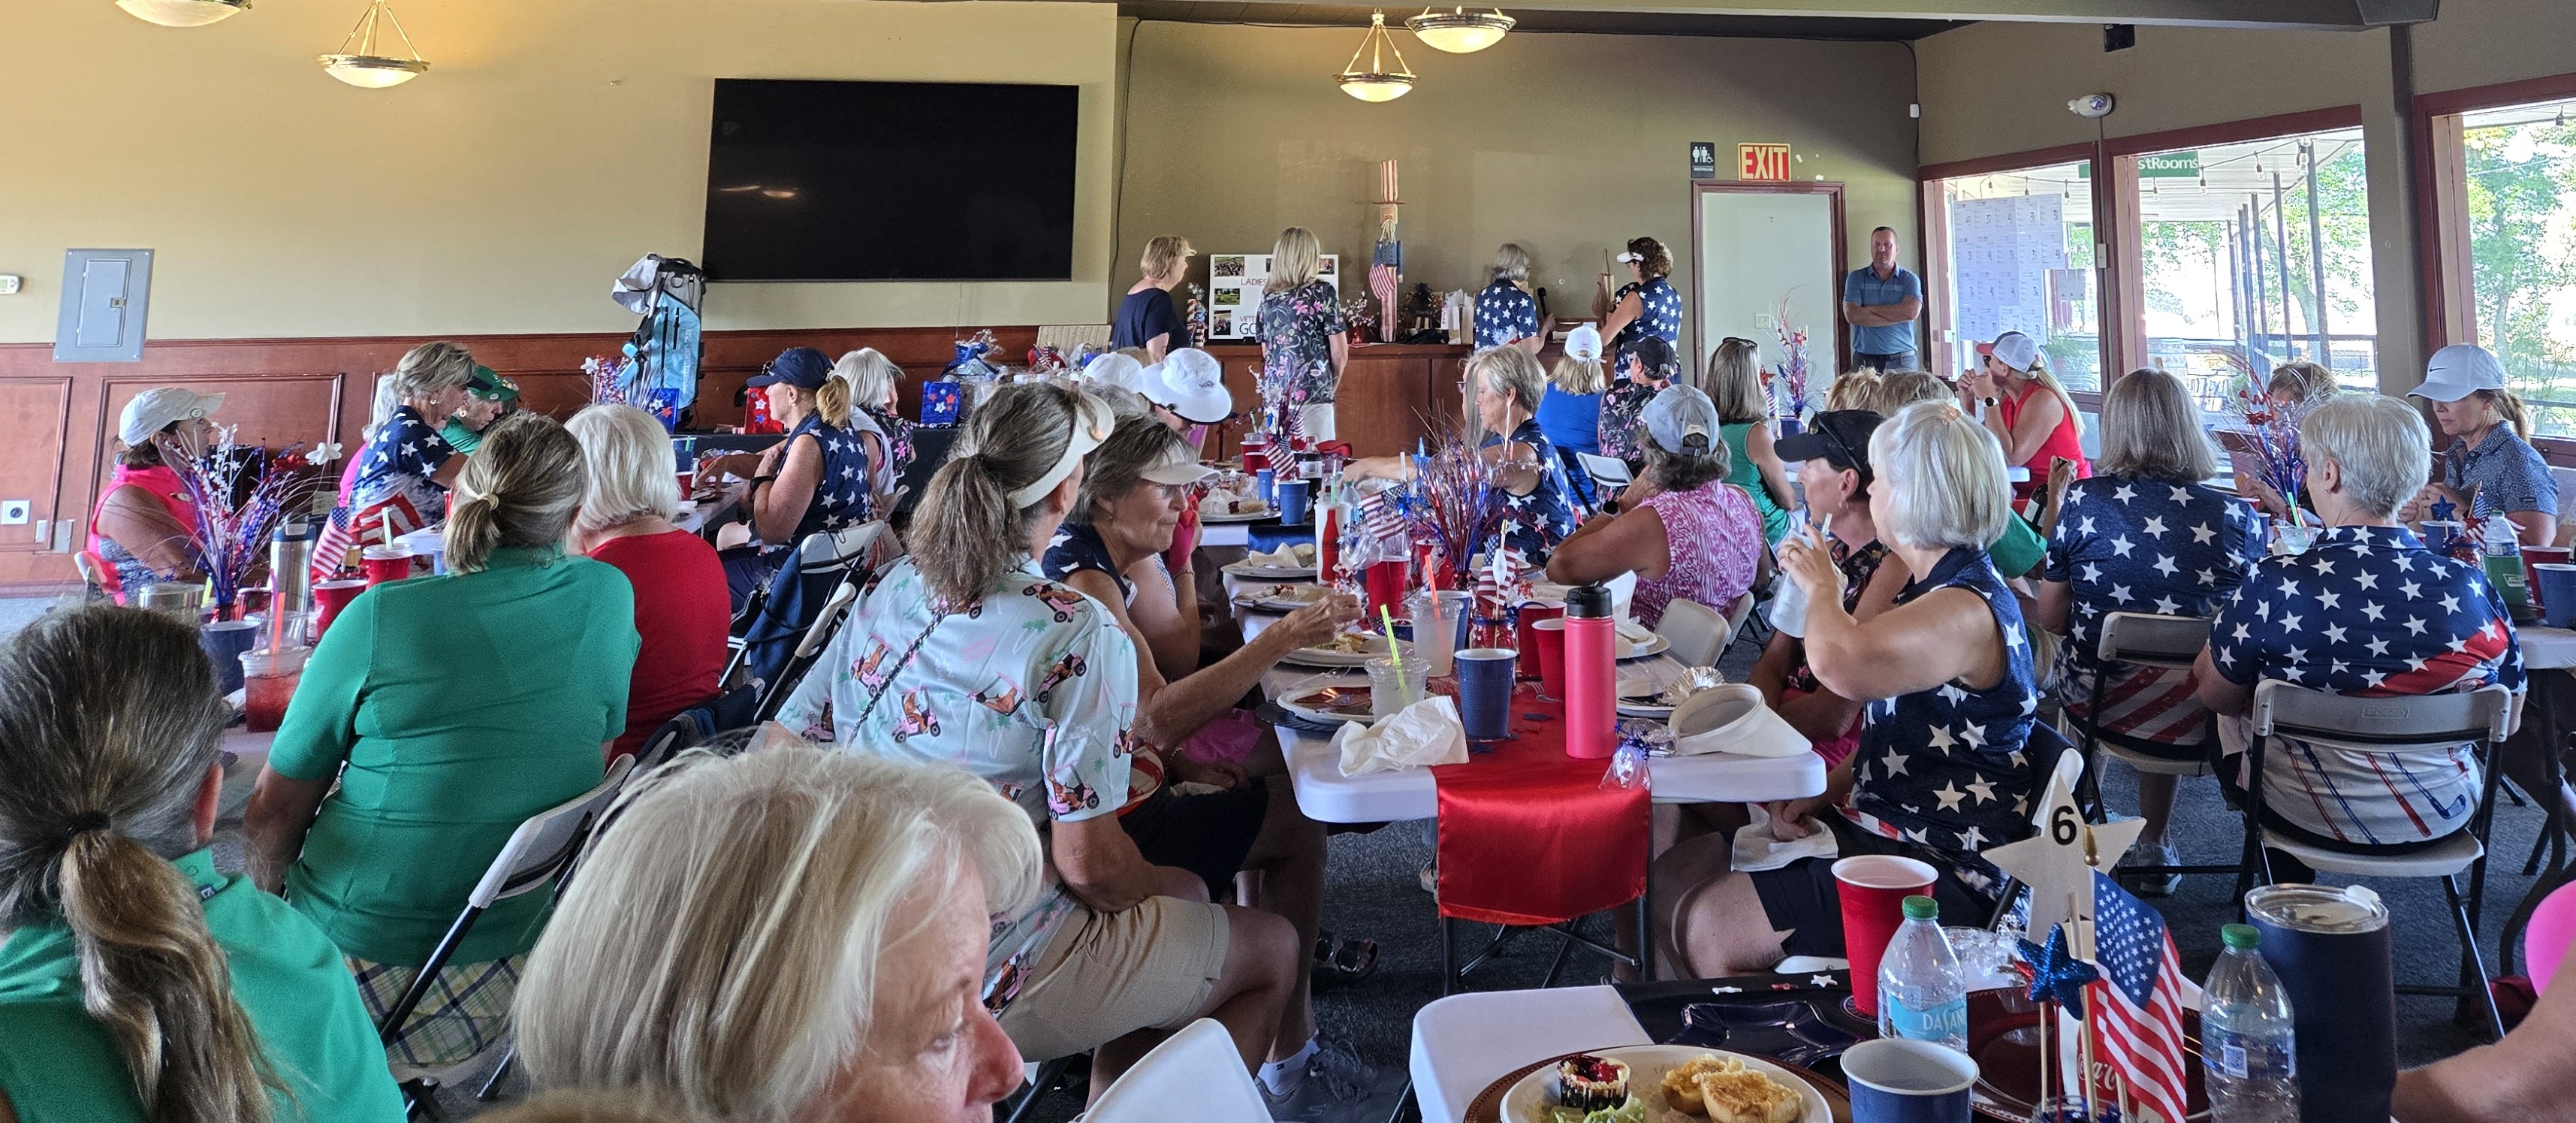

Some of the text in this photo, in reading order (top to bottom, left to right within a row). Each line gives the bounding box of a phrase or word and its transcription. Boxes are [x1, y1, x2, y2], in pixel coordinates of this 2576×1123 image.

[1741, 146, 1787, 180] EXIT
[2137, 157, 2199, 170] stRooms
[1241, 278, 1268, 286] LADIES
[1239, 322, 1256, 335] GO
[2051, 805, 2077, 847] 6
[1923, 1007, 1965, 1036] DASAN
